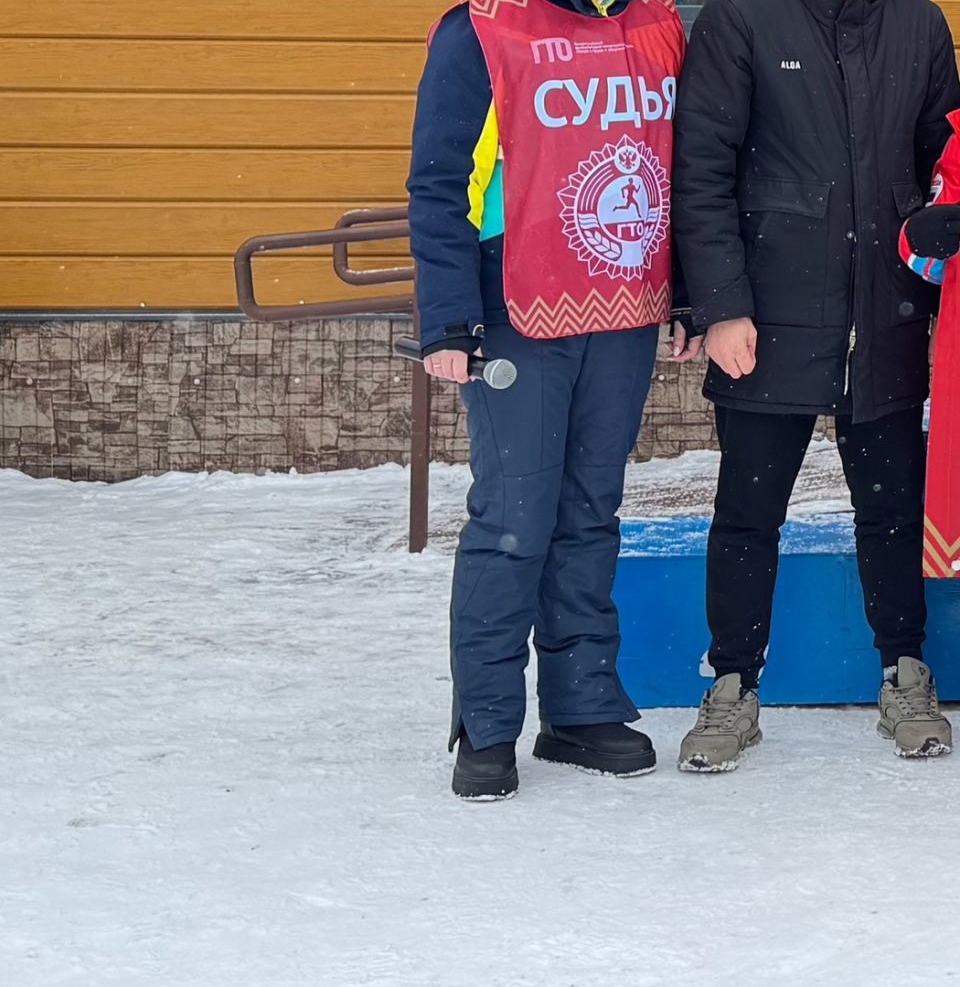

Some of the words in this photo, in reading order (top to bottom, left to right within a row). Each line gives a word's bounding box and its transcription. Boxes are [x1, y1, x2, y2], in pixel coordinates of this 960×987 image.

[530, 37, 574, 64] ГТО
[534, 75, 677, 131] СУДЬЯ
[616, 223, 644, 238] ГТО
